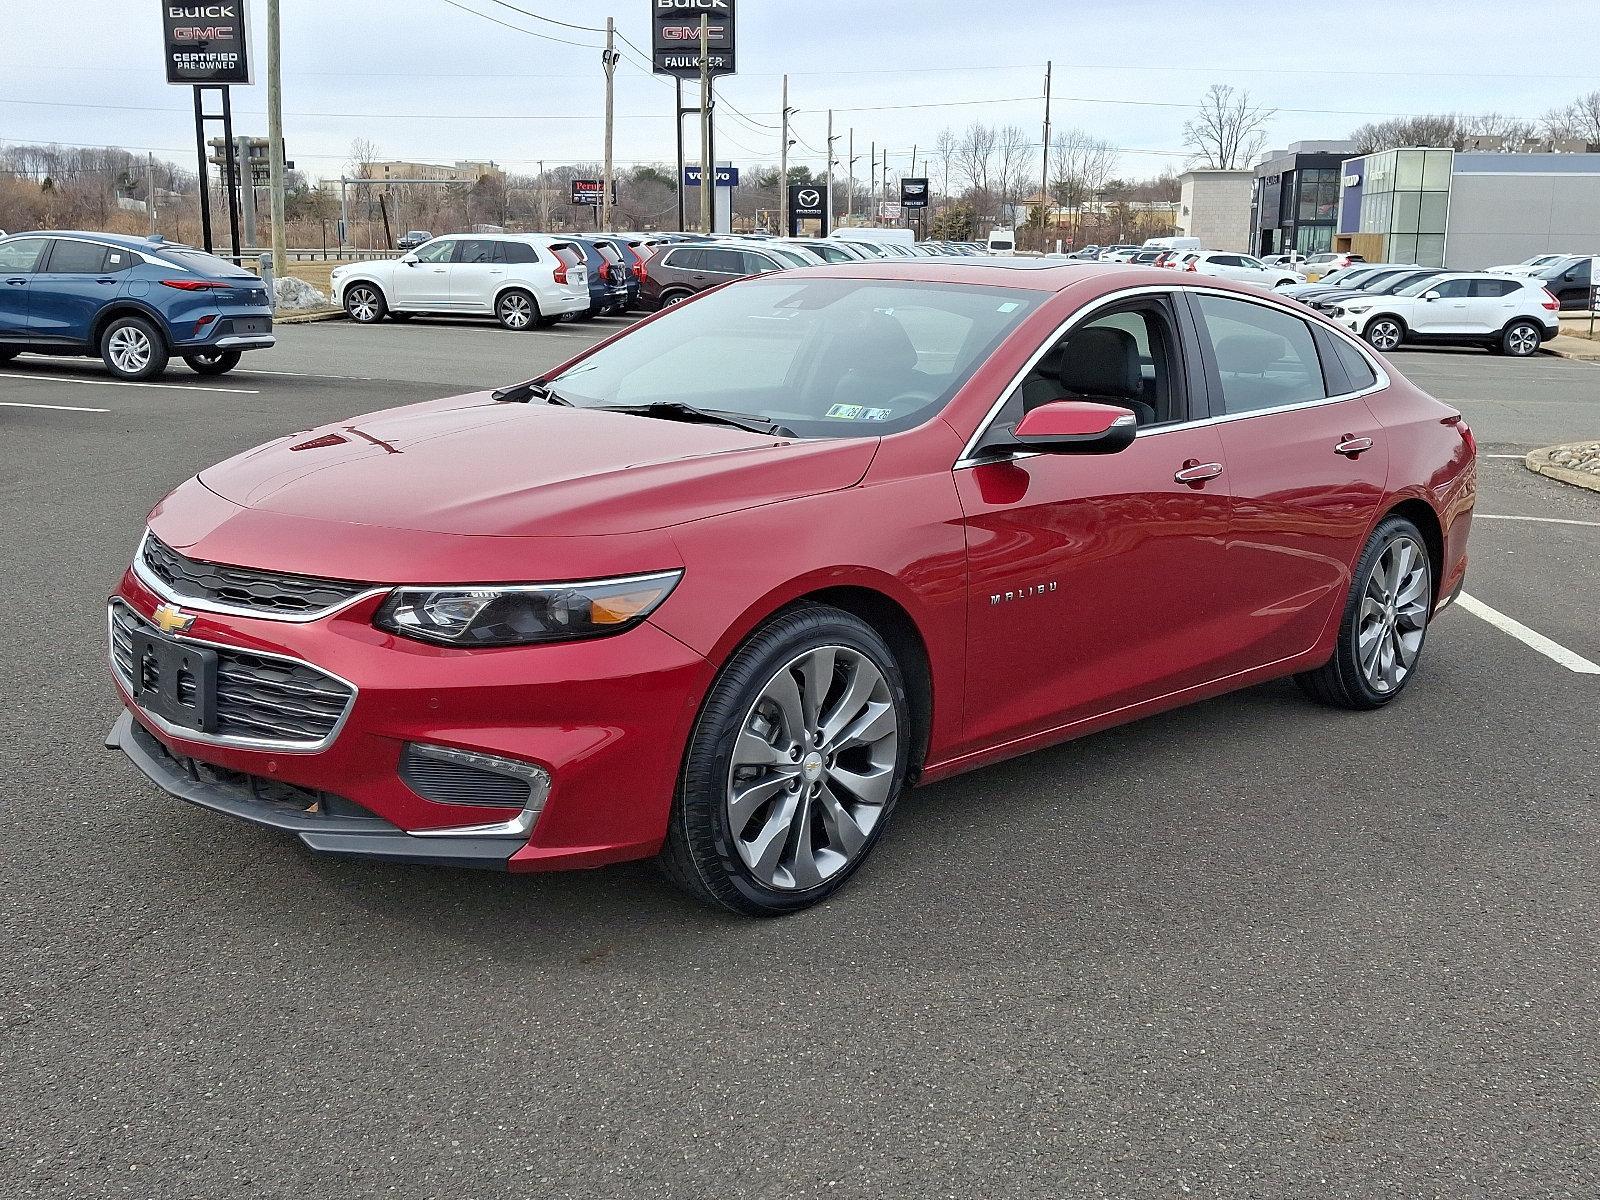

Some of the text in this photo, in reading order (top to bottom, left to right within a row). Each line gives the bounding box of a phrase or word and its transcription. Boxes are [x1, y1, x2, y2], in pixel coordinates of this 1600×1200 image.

[169, 6, 235, 18] BUICK
[174, 27, 234, 40] GMC
[663, 27, 723, 39] GMC
[173, 53, 238, 61] CERTIFIED
[665, 57, 723, 67] FAULKER
[990, 581, 1058, 605] MALIBU
